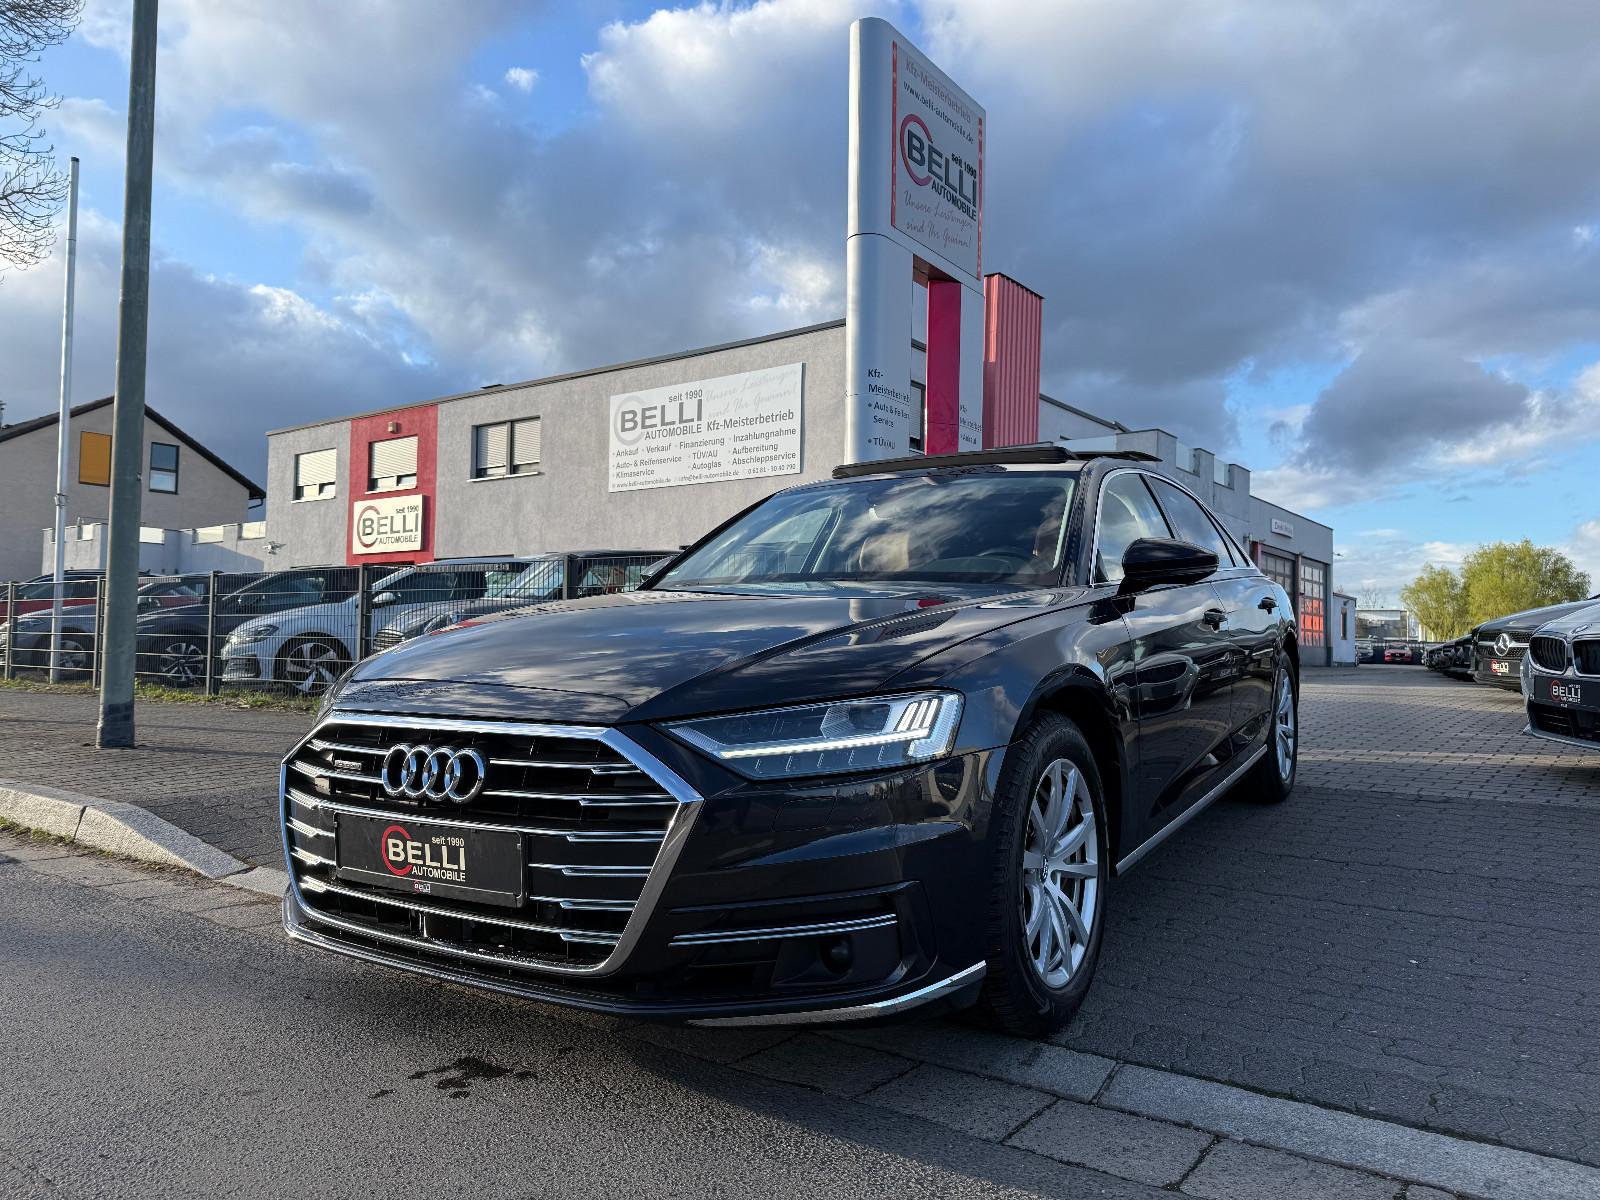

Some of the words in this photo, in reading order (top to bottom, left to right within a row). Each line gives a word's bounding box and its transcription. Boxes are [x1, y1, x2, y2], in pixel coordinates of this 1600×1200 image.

[907, 128, 977, 208] BELLI
[951, 153, 963, 168] seit
[964, 161, 977, 179] 1990
[931, 179, 977, 221] AUTOMOBILE
[868, 368, 884, 378] Kfz-
[668, 392, 683, 403] seit
[685, 388, 703, 400] 1990
[868, 383, 910, 403] Meisterbetrieb
[620, 399, 703, 432] BELLI
[707, 408, 794, 432] Kfz-Meisterbetrieb
[644, 423, 703, 440] AUTOMOBILE
[616, 447, 639, 457] Ankauf
[646, 443, 672, 454] Verkauf
[679, 437, 725, 450] Finanzierung
[733, 428, 796, 443] Inzahlungnahme
[732, 443, 778, 455] Aufbereitung
[692, 450, 718, 460] TÜV/AU
[732, 452, 796, 466] Abschleppservice
[616, 461, 633, 470] Auto-
[633, 460, 638, 468] &
[639, 456, 682, 467] Reifenservice
[691, 460, 722, 470] Autoglas
[616, 469, 655, 479] Klimaservice
[395, 506, 405, 514] seit
[407, 504, 419, 513] 1990
[361, 512, 419, 536] BELLI
[378, 534, 419, 545] AUTOMOBILE
[1552, 685, 1581, 698] BELLI
[431, 835, 446, 845] seit
[446, 836, 465, 847] 1990
[387, 838, 466, 870] BELLI
[411, 865, 466, 882] AUTOMOBILE
